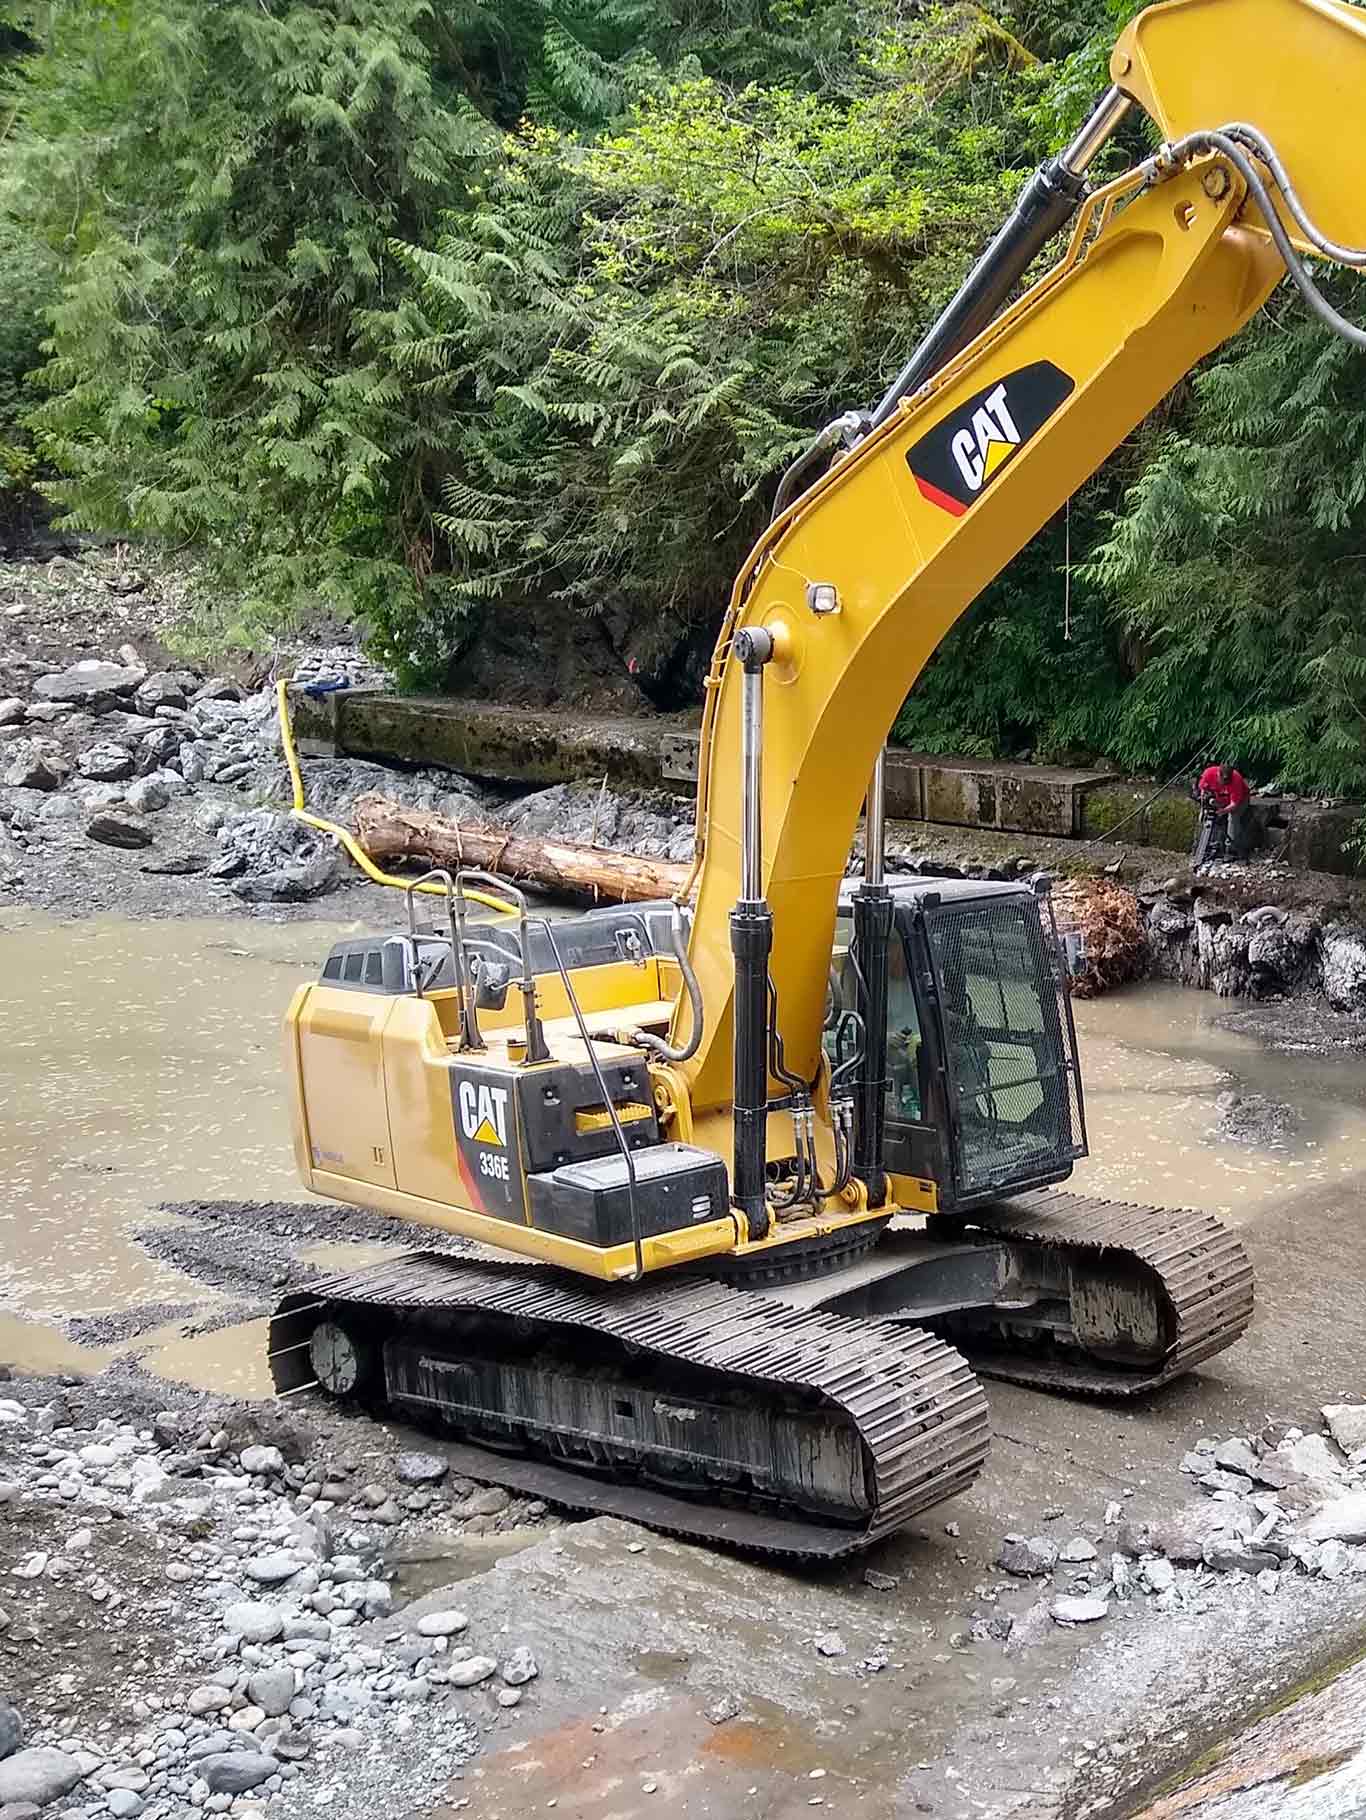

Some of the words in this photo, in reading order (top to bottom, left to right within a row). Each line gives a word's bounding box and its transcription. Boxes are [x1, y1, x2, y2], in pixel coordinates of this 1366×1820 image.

[951, 383, 1022, 491] CAT
[459, 1081, 507, 1147] CAT
[479, 1151, 510, 1181] 336E
